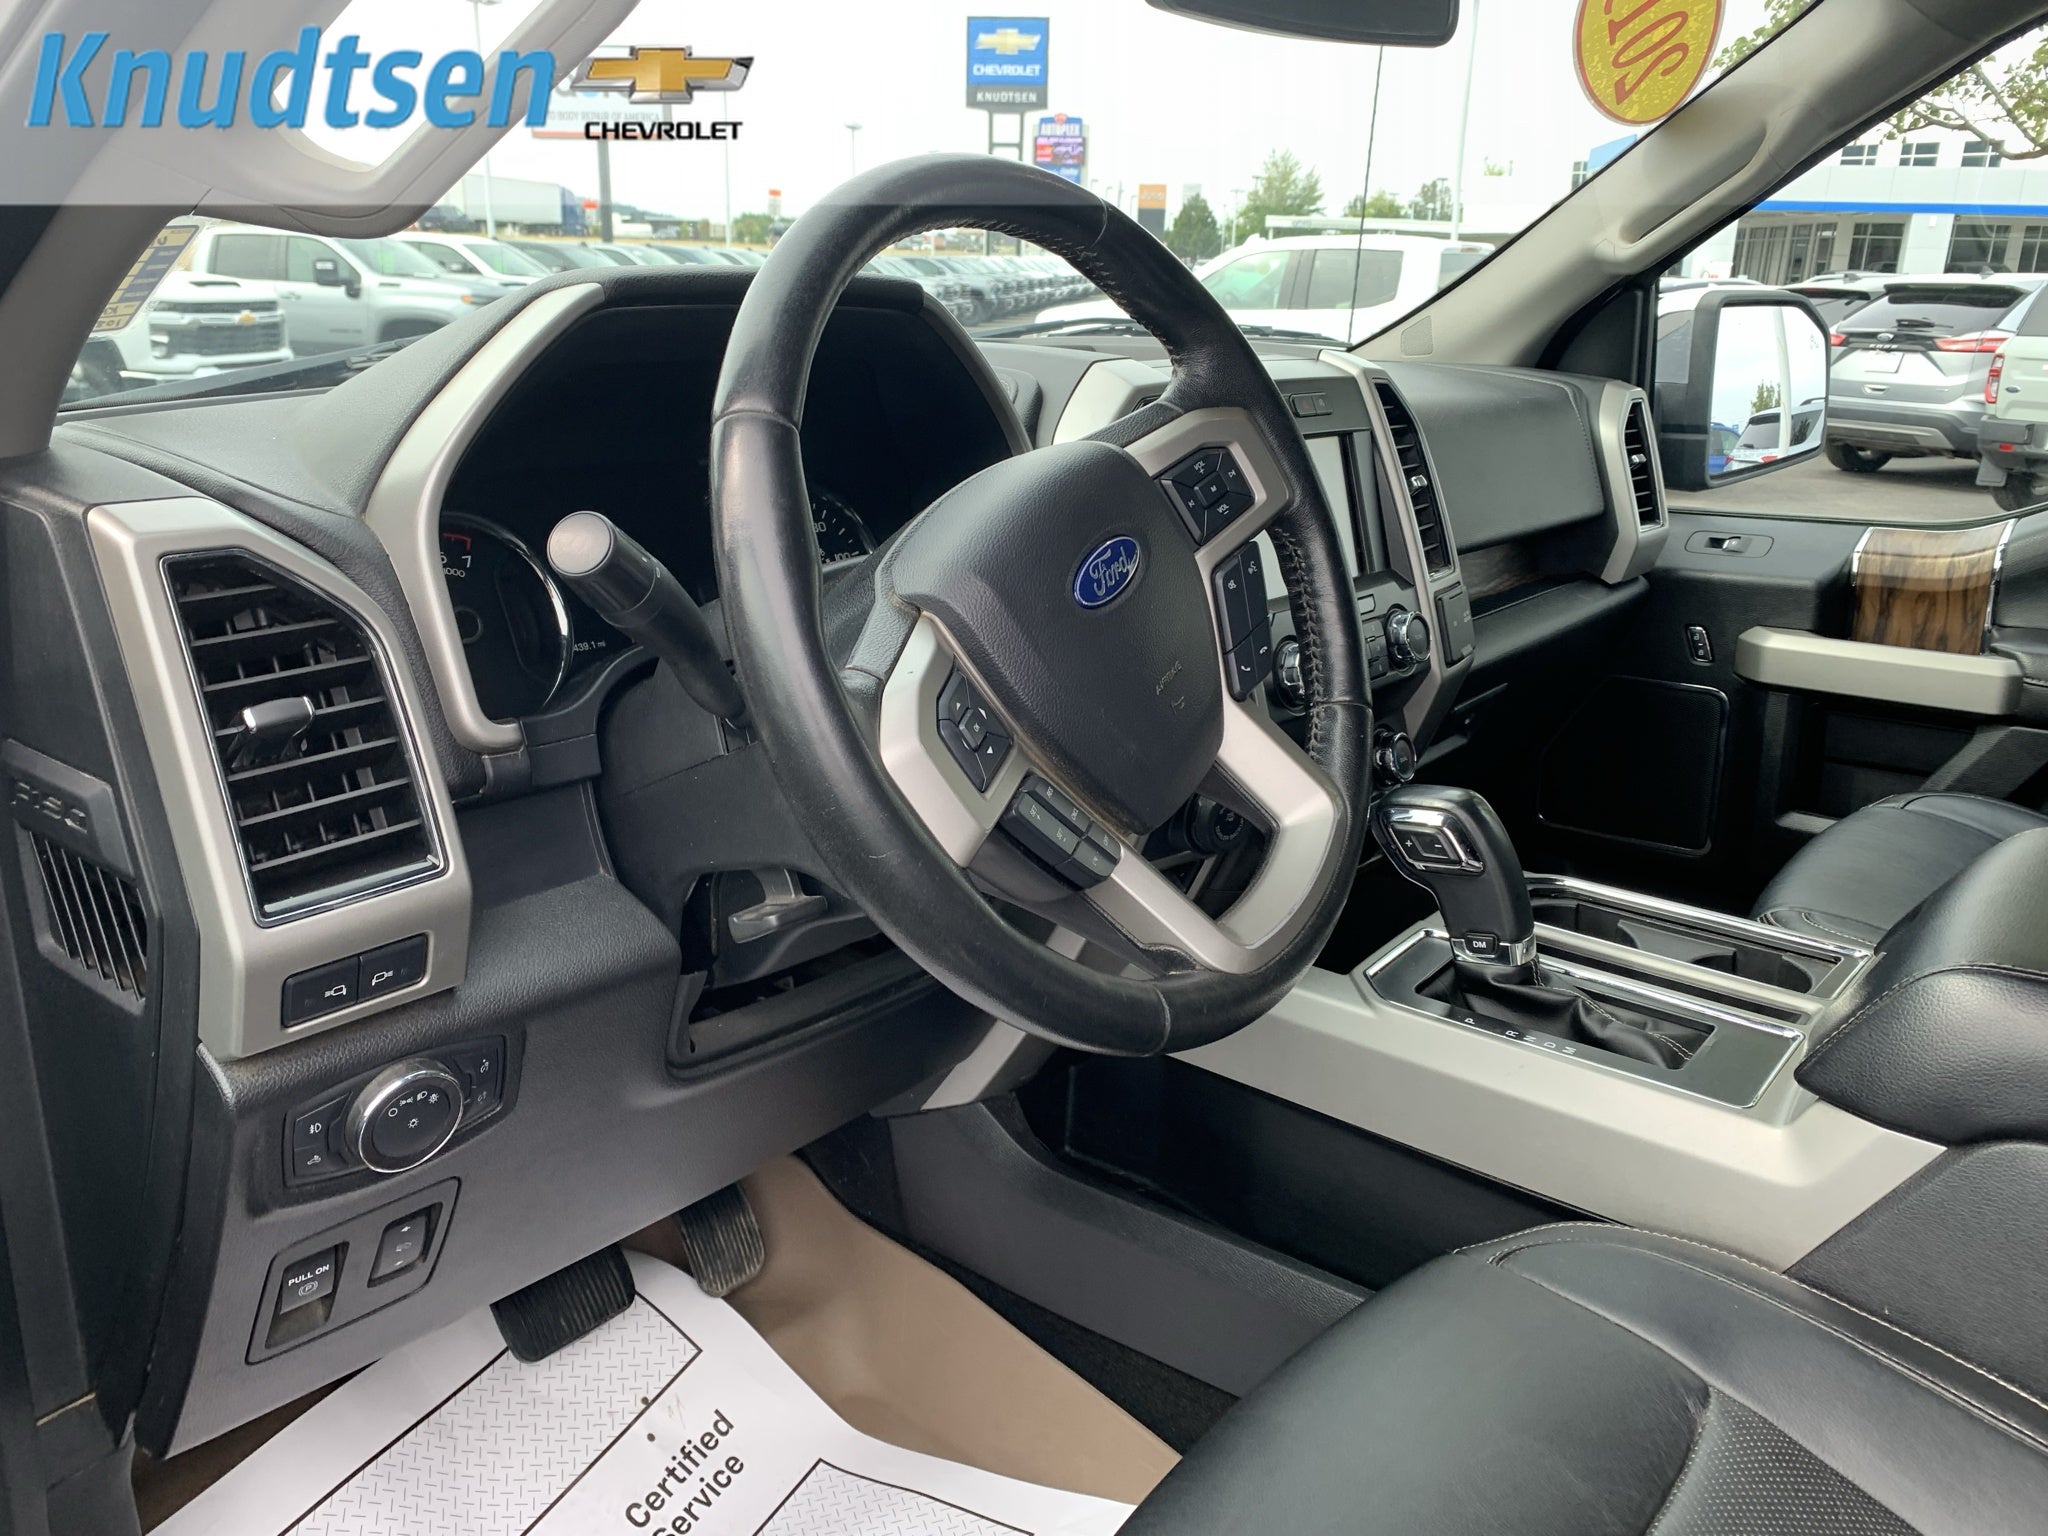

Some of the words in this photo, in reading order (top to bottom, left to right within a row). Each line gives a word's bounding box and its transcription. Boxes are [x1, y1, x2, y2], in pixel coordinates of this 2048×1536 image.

[972, 63, 1042, 77] CHEVROLET
[976, 91, 1037, 103] KNUDTSEN
[623, 112, 660, 121] AMERICA
[1193, 460, 1206, 471] VOL
[1216, 503, 1230, 513] VOL
[461, 555, 472, 568] 7
[1089, 545, 1138, 597] Ford
[1472, 940, 1487, 949] DM
[1464, 1017, 1475, 1025] P
[1505, 1030, 1519, 1038] R
[1523, 1035, 1537, 1043] N
[1544, 1041, 1556, 1050] D
[1562, 1046, 1577, 1055] M
[288, 1271, 314, 1286] PULL
[315, 1263, 330, 1275] ON
[625, 1408, 735, 1529] Certified
